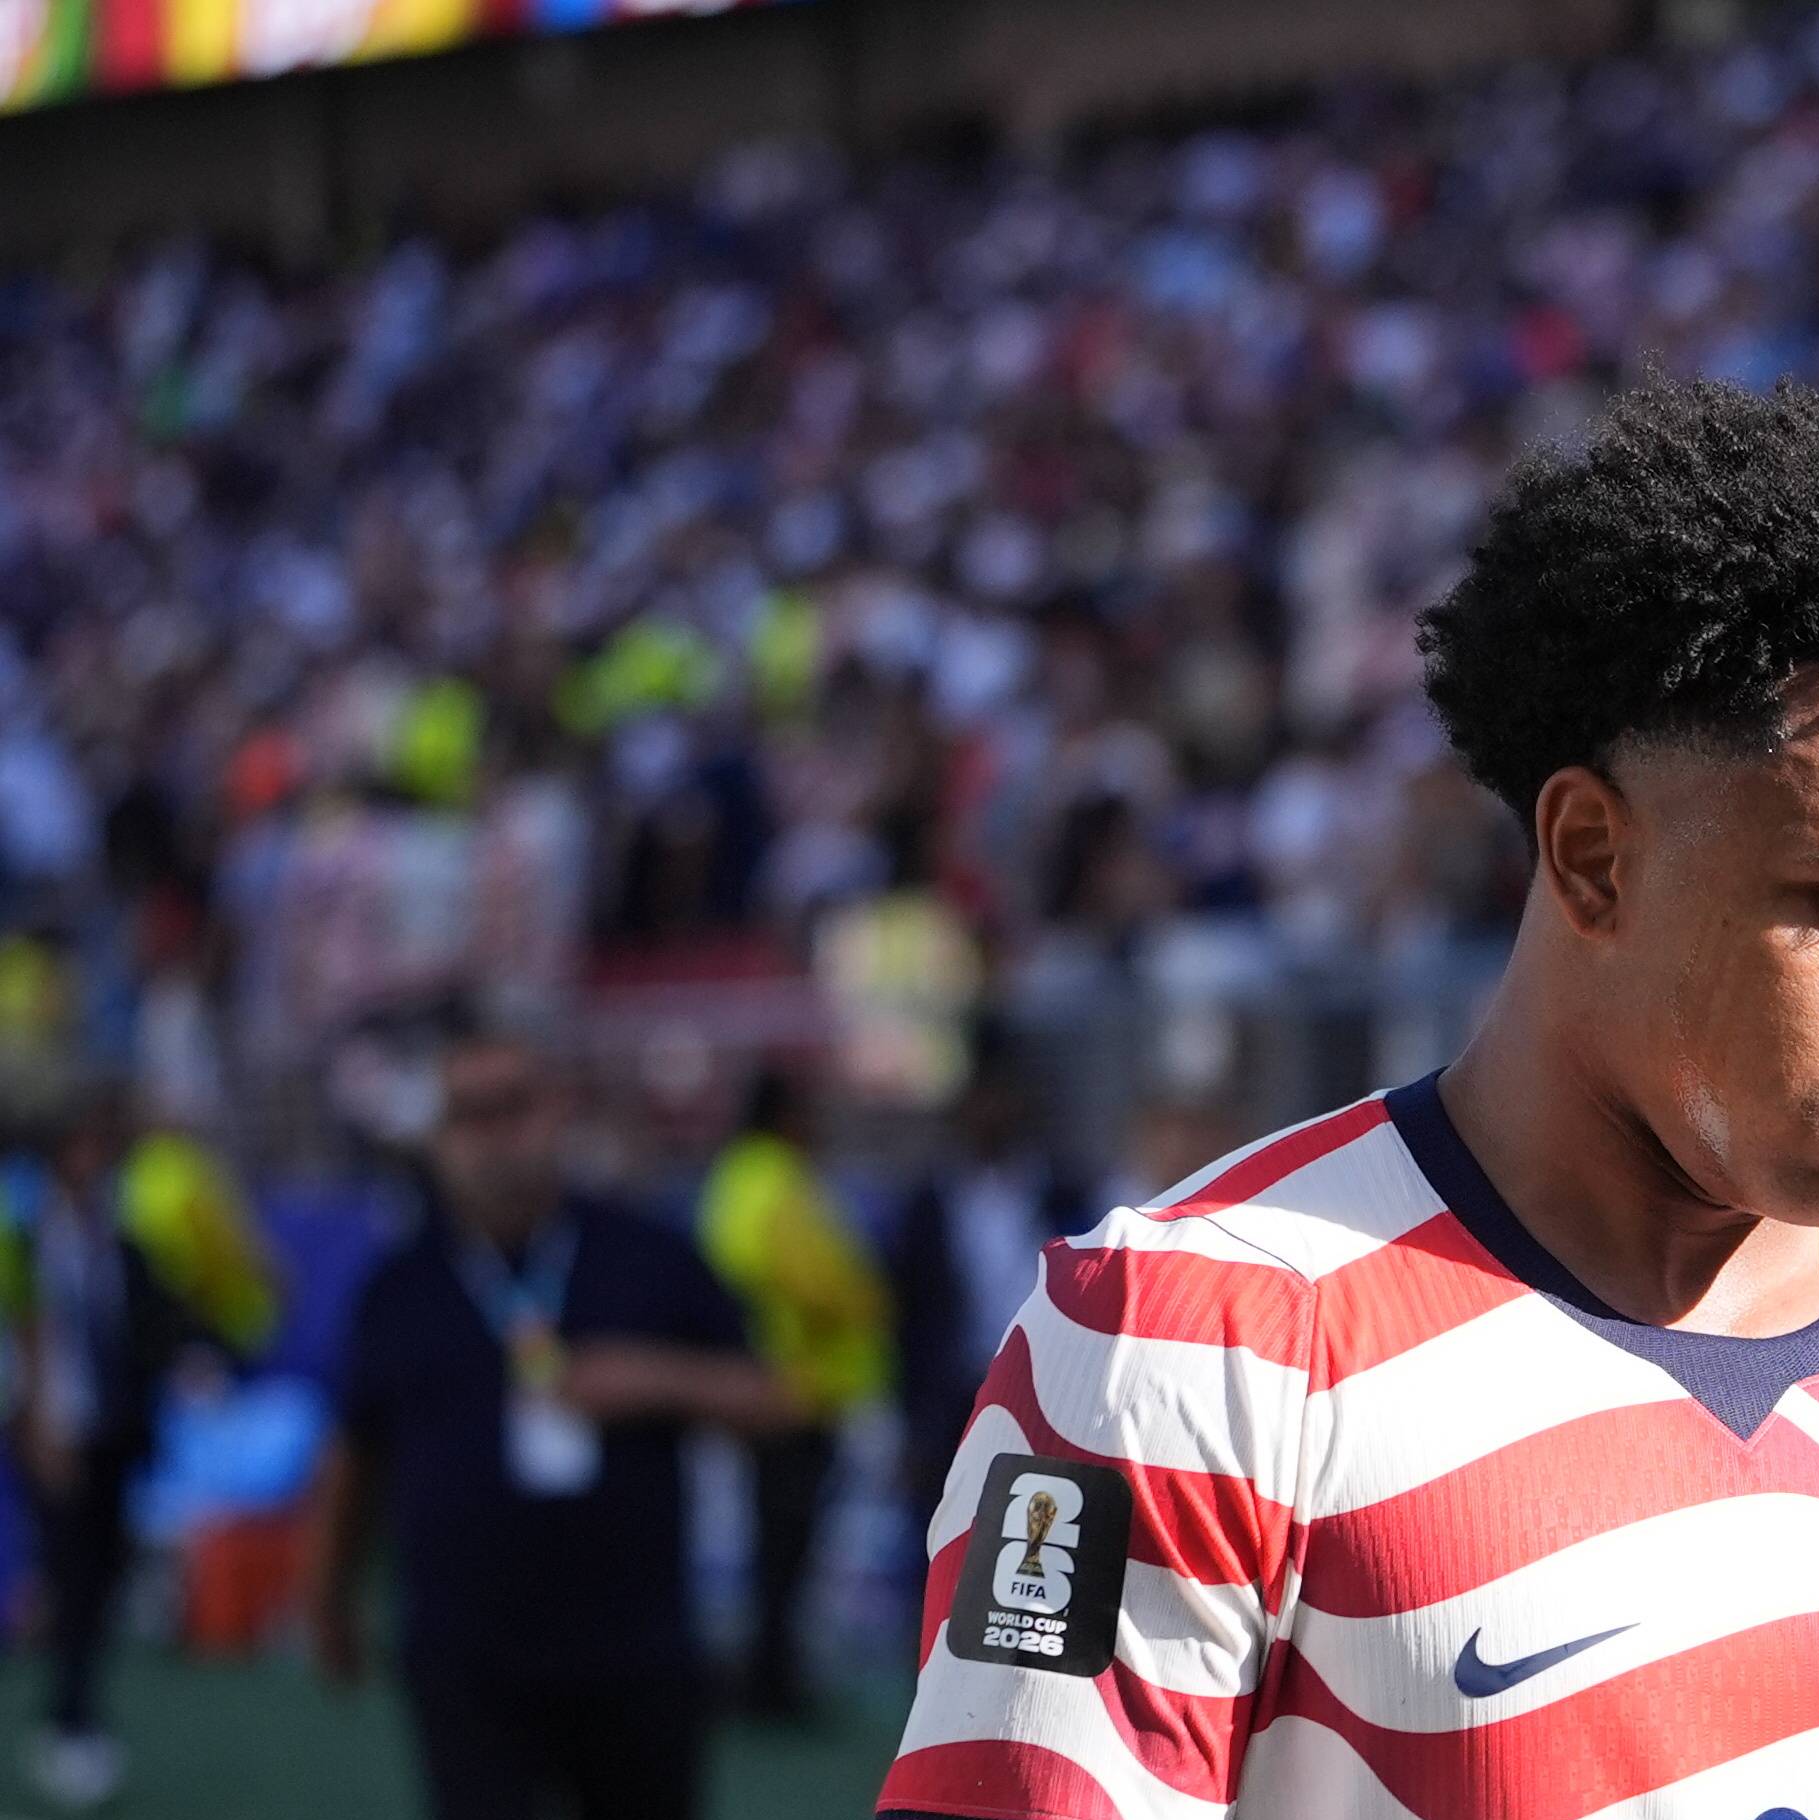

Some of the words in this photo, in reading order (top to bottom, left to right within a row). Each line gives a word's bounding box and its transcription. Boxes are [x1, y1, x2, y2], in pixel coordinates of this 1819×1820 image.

[1011, 1581, 1046, 1600] FIFA
[988, 1610, 1034, 1629] WORLD
[1034, 1617, 1068, 1635] CUP
[982, 1625, 1065, 1657] 2026
